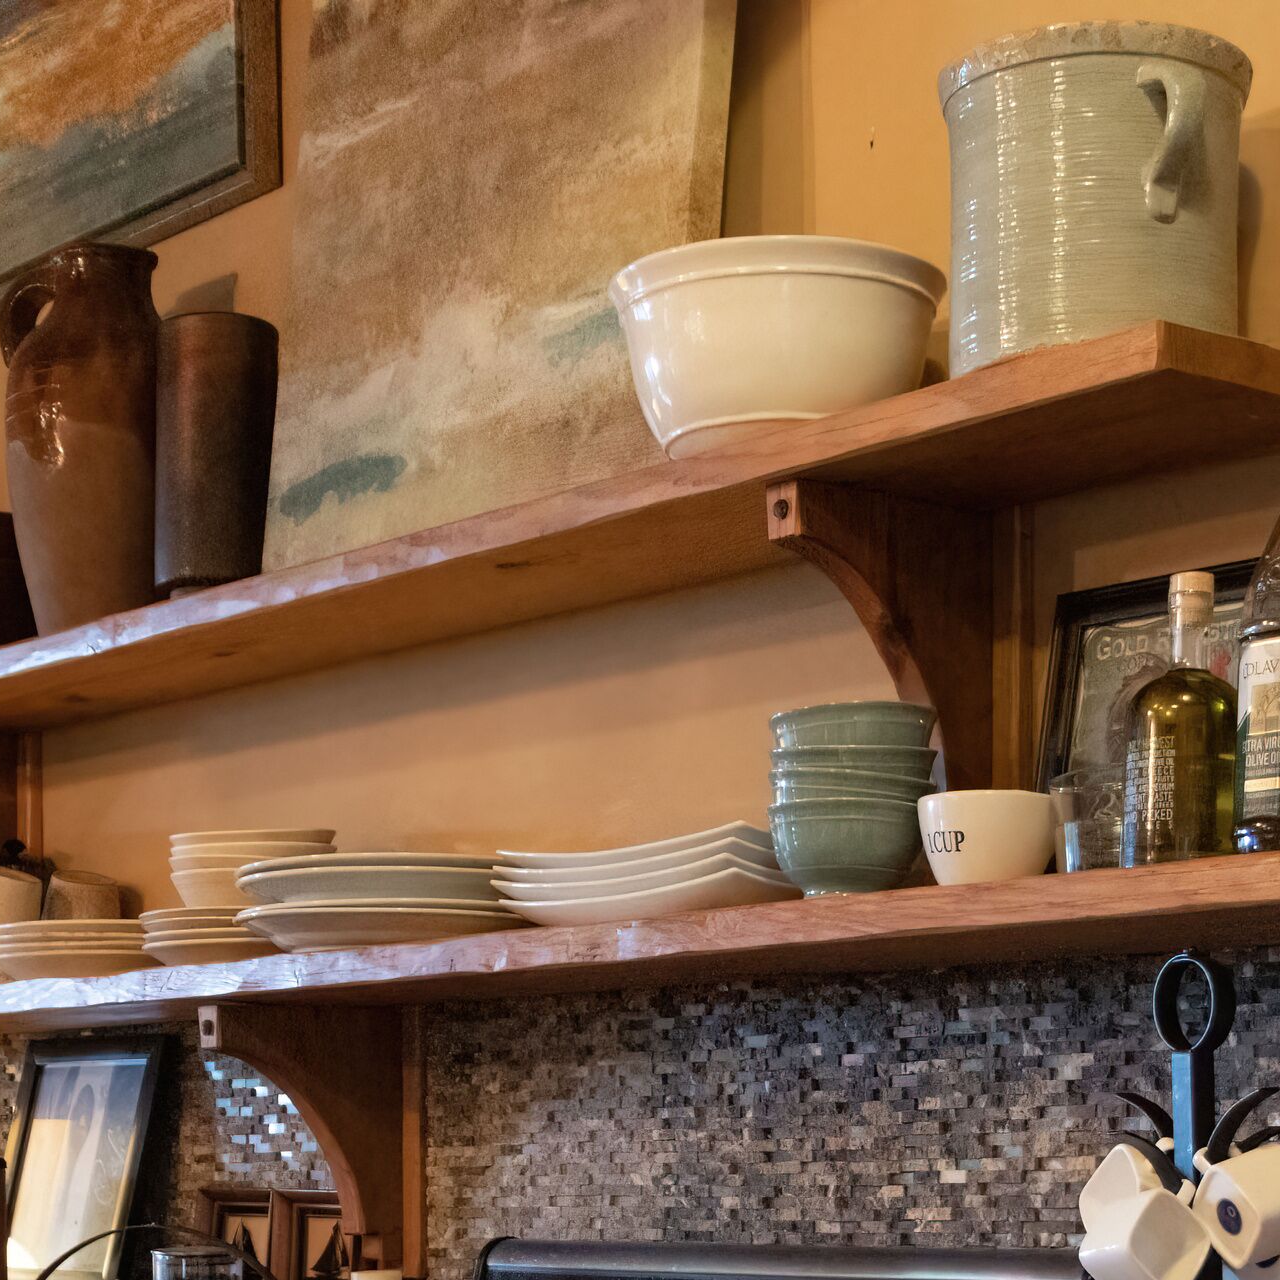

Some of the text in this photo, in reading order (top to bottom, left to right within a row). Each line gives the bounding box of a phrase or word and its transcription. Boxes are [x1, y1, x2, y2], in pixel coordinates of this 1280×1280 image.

[1096, 635, 1149, 661] GOLD
[1245, 752, 1269, 767] OLIVE
[1141, 808, 1173, 822] PCKED
[927, 830, 965, 853] 1 CUP
